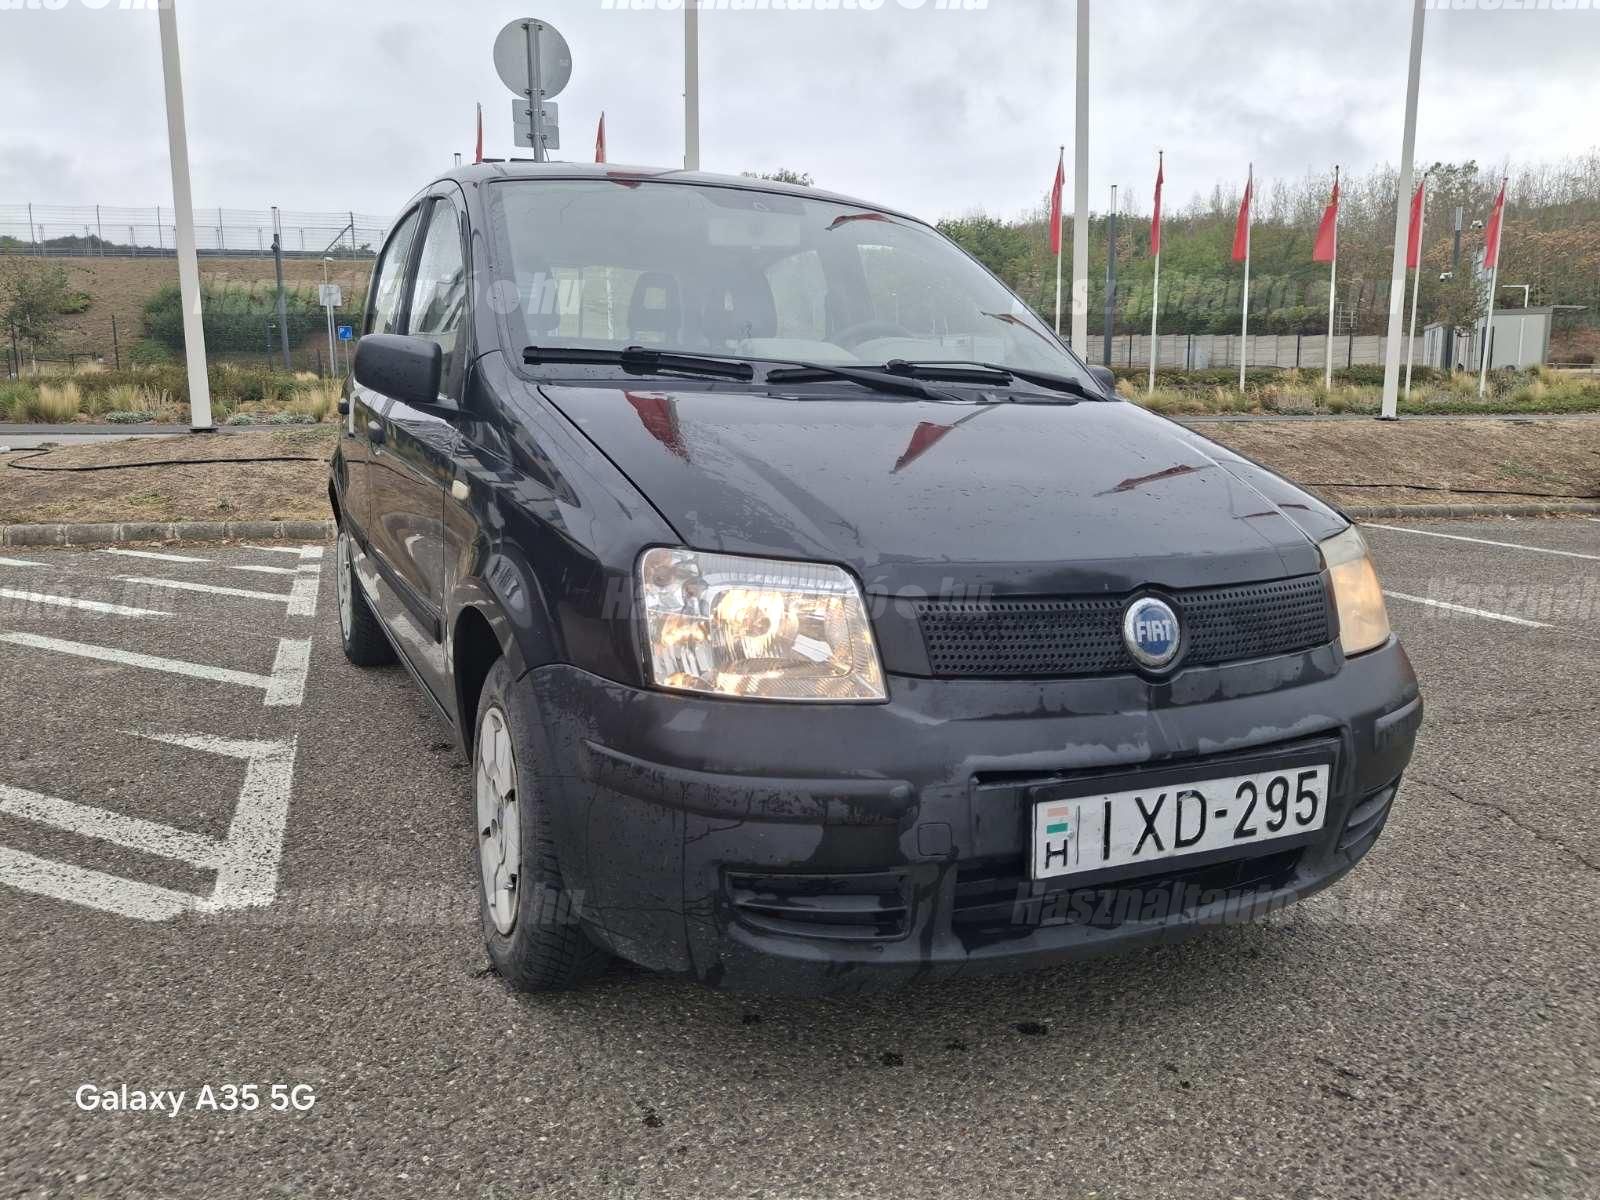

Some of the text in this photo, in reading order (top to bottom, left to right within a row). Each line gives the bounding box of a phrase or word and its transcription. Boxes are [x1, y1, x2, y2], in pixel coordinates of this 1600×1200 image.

[1136, 620, 1171, 643] FIAT
[1045, 770, 1319, 869] H IXD-295
